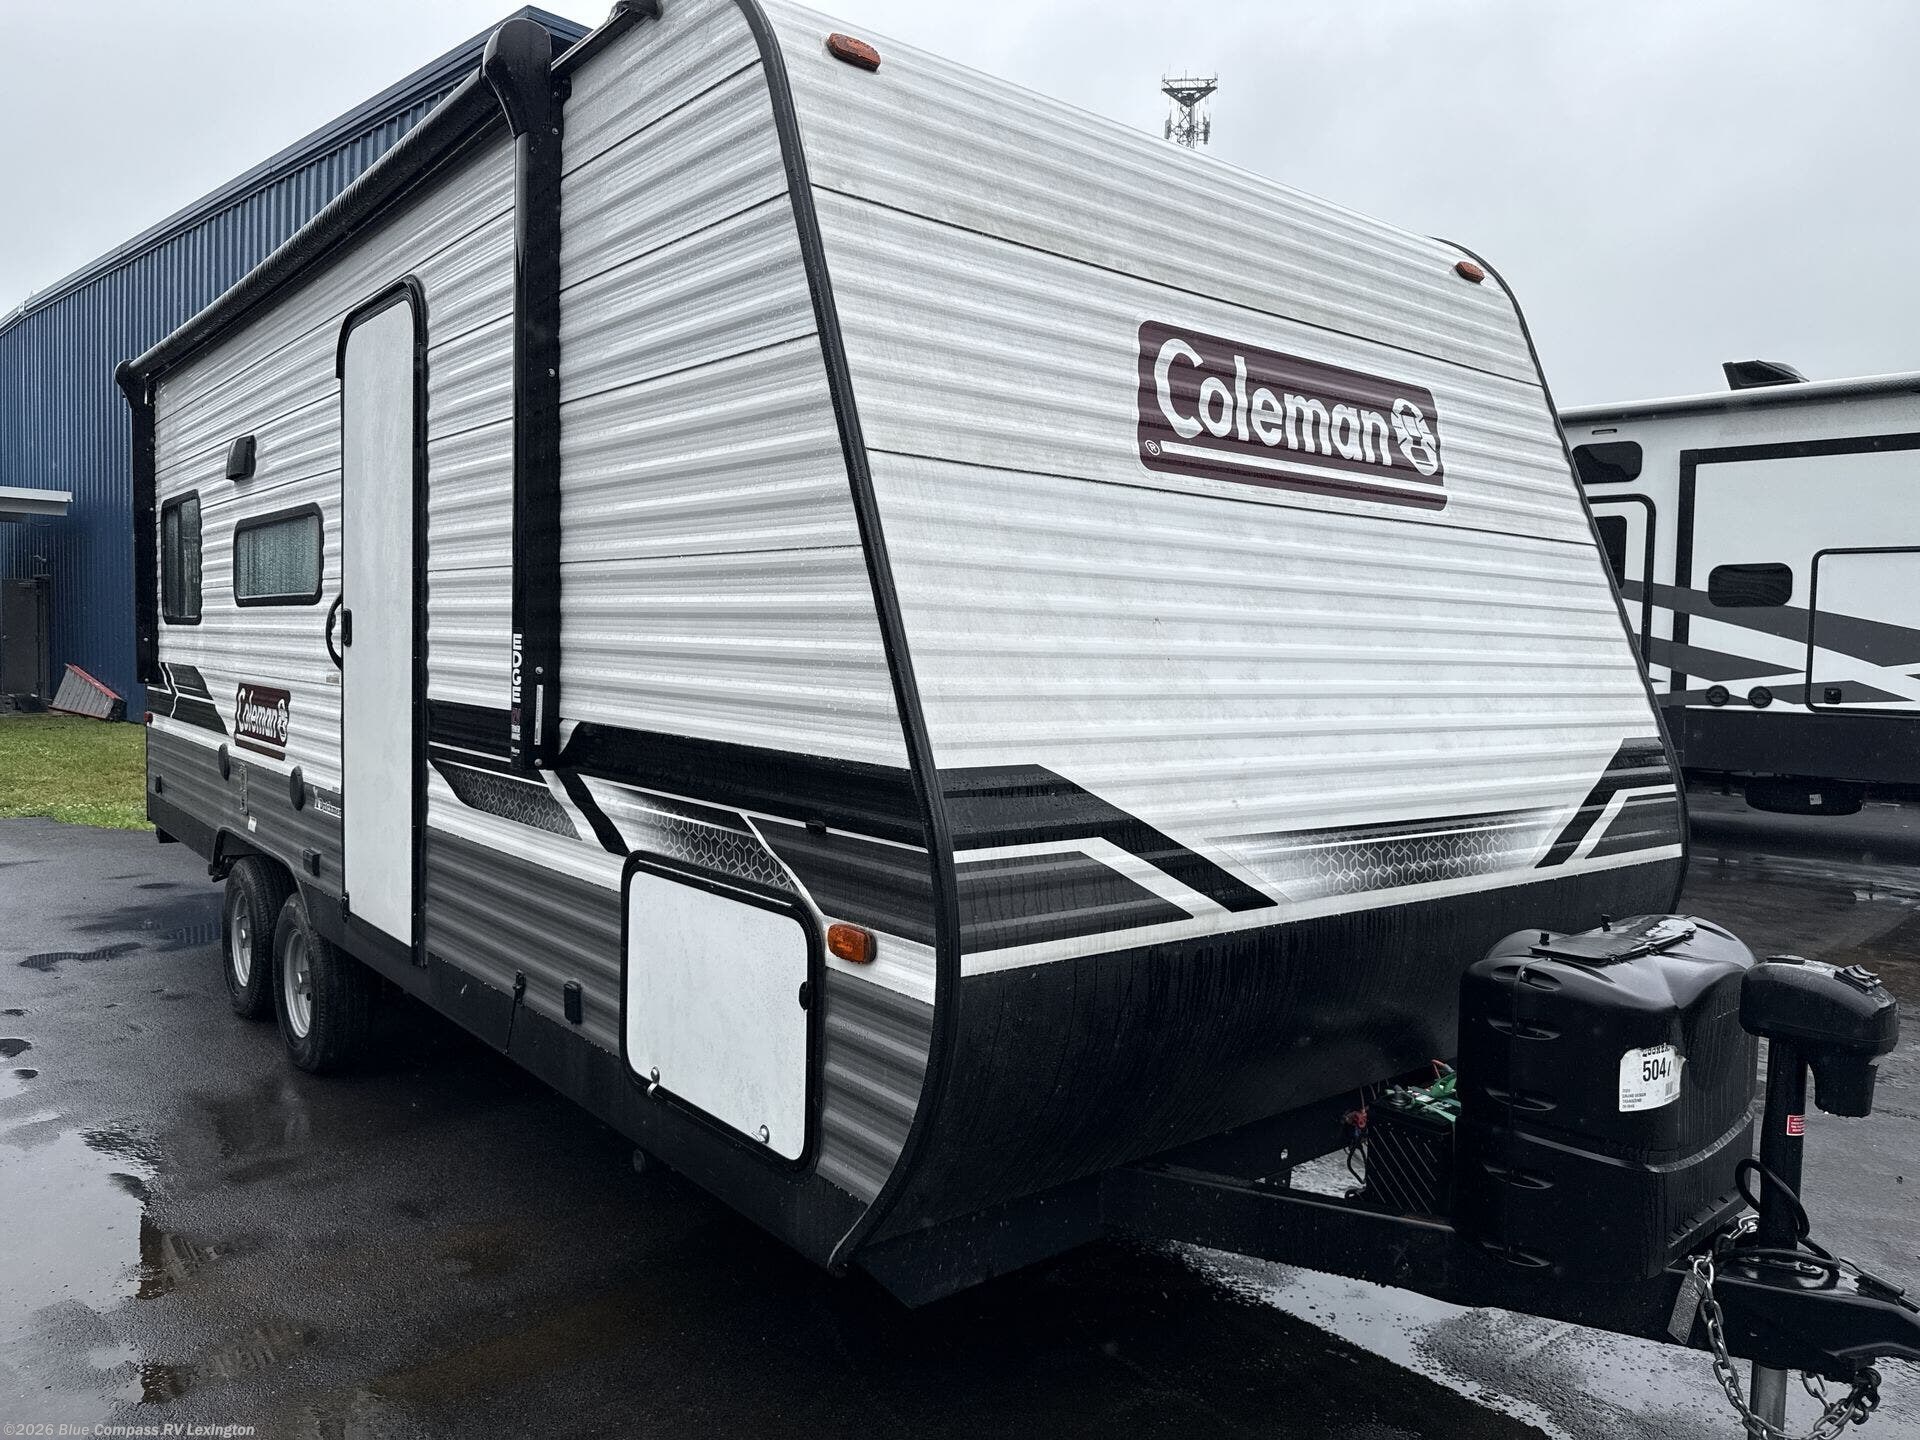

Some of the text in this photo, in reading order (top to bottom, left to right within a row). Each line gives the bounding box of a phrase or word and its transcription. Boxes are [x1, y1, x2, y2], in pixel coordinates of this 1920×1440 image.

[1154, 338, 1392, 466] Coleman
[512, 633, 523, 703] EDGE
[236, 687, 278, 739] Coleman
